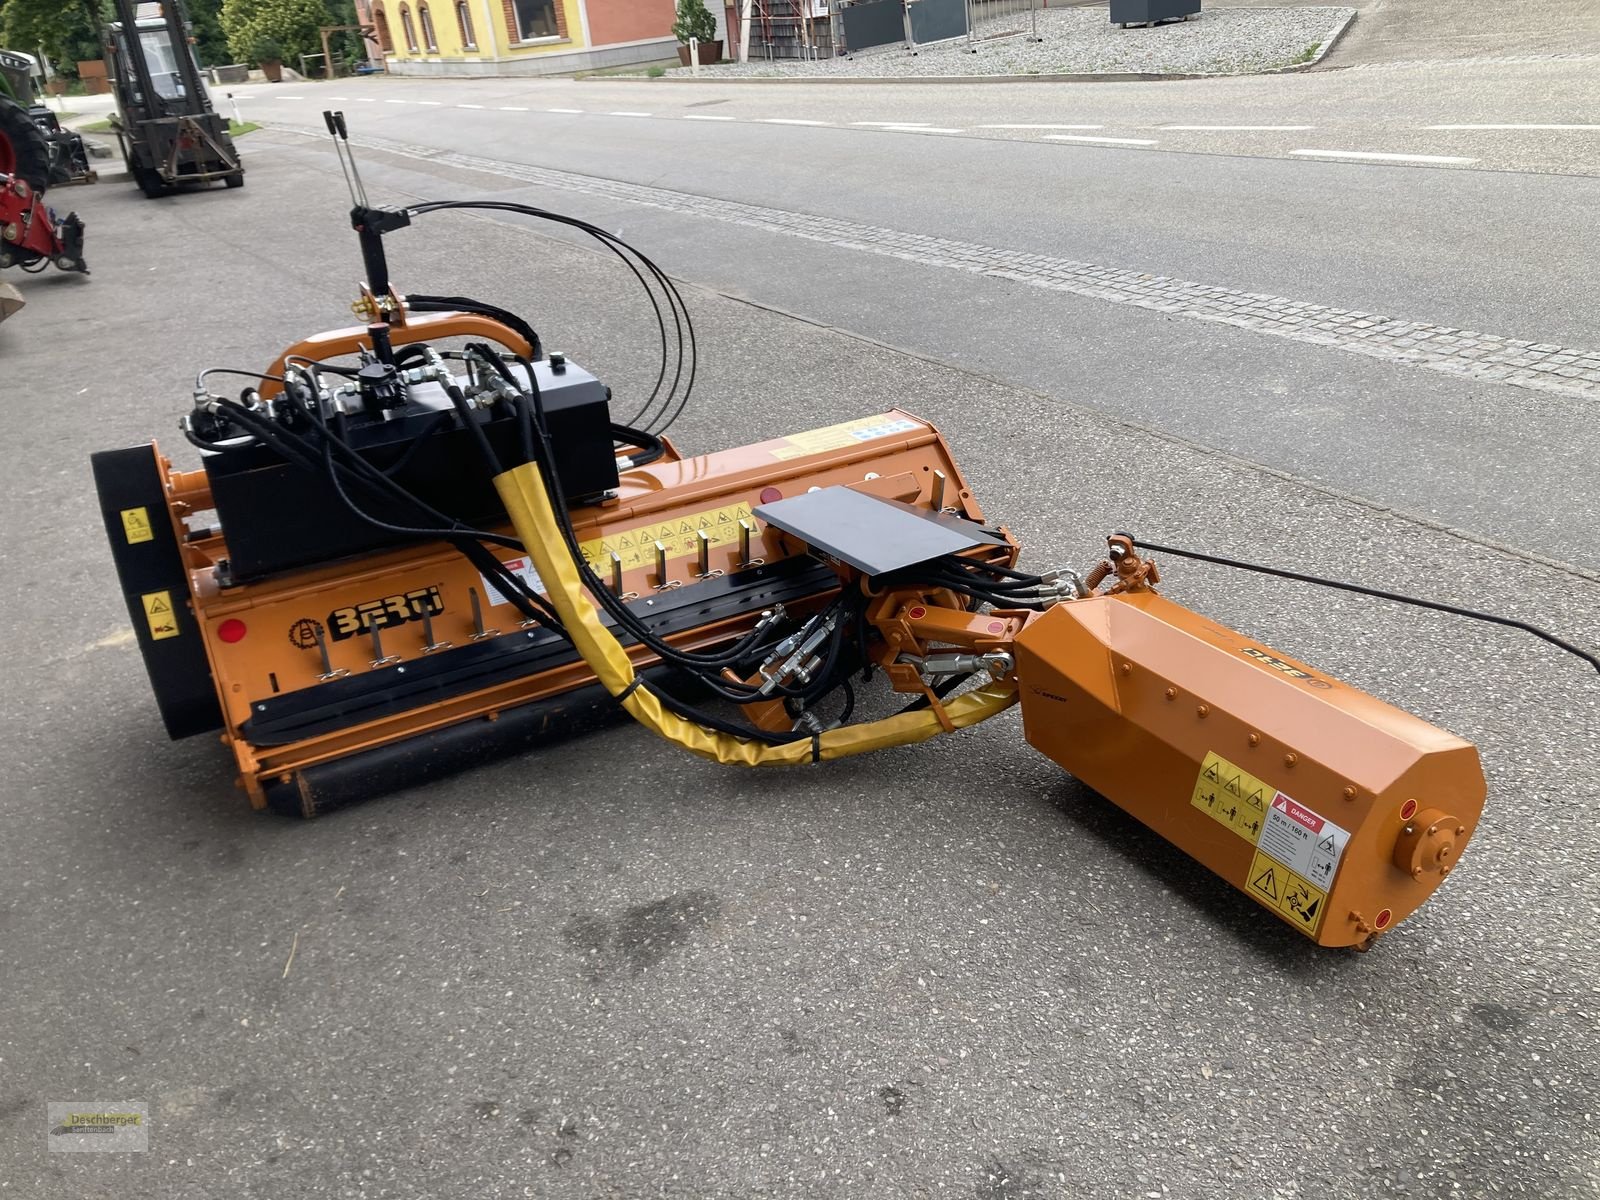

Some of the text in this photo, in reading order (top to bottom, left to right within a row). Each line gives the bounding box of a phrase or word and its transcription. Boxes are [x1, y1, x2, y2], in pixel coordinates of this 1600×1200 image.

[327, 585, 445, 641] BERTI
[1272, 814, 1281, 823] 50
[1290, 808, 1316, 827] DANGER
